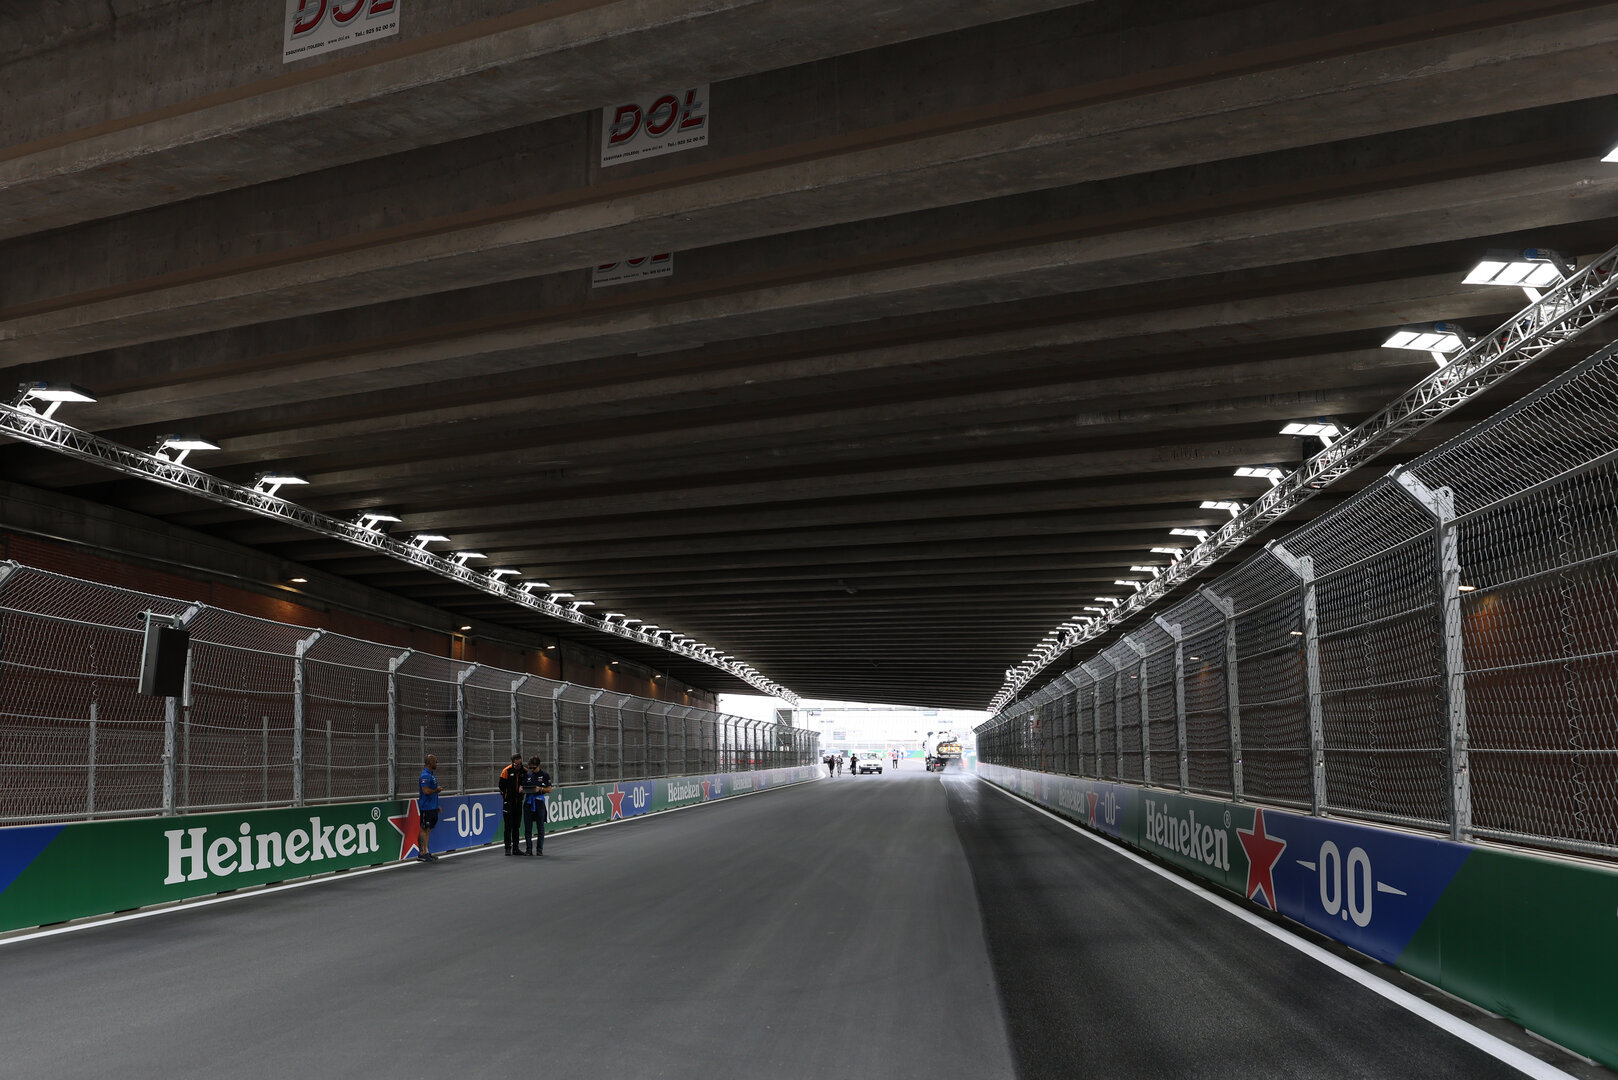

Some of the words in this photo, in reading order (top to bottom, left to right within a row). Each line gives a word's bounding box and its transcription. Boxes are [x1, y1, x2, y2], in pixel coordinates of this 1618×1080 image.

[607, 88, 707, 149] DOL
[668, 780, 700, 802] Heineken
[457, 802, 484, 838] 0.0
[1318, 840, 1373, 928] 0.0
